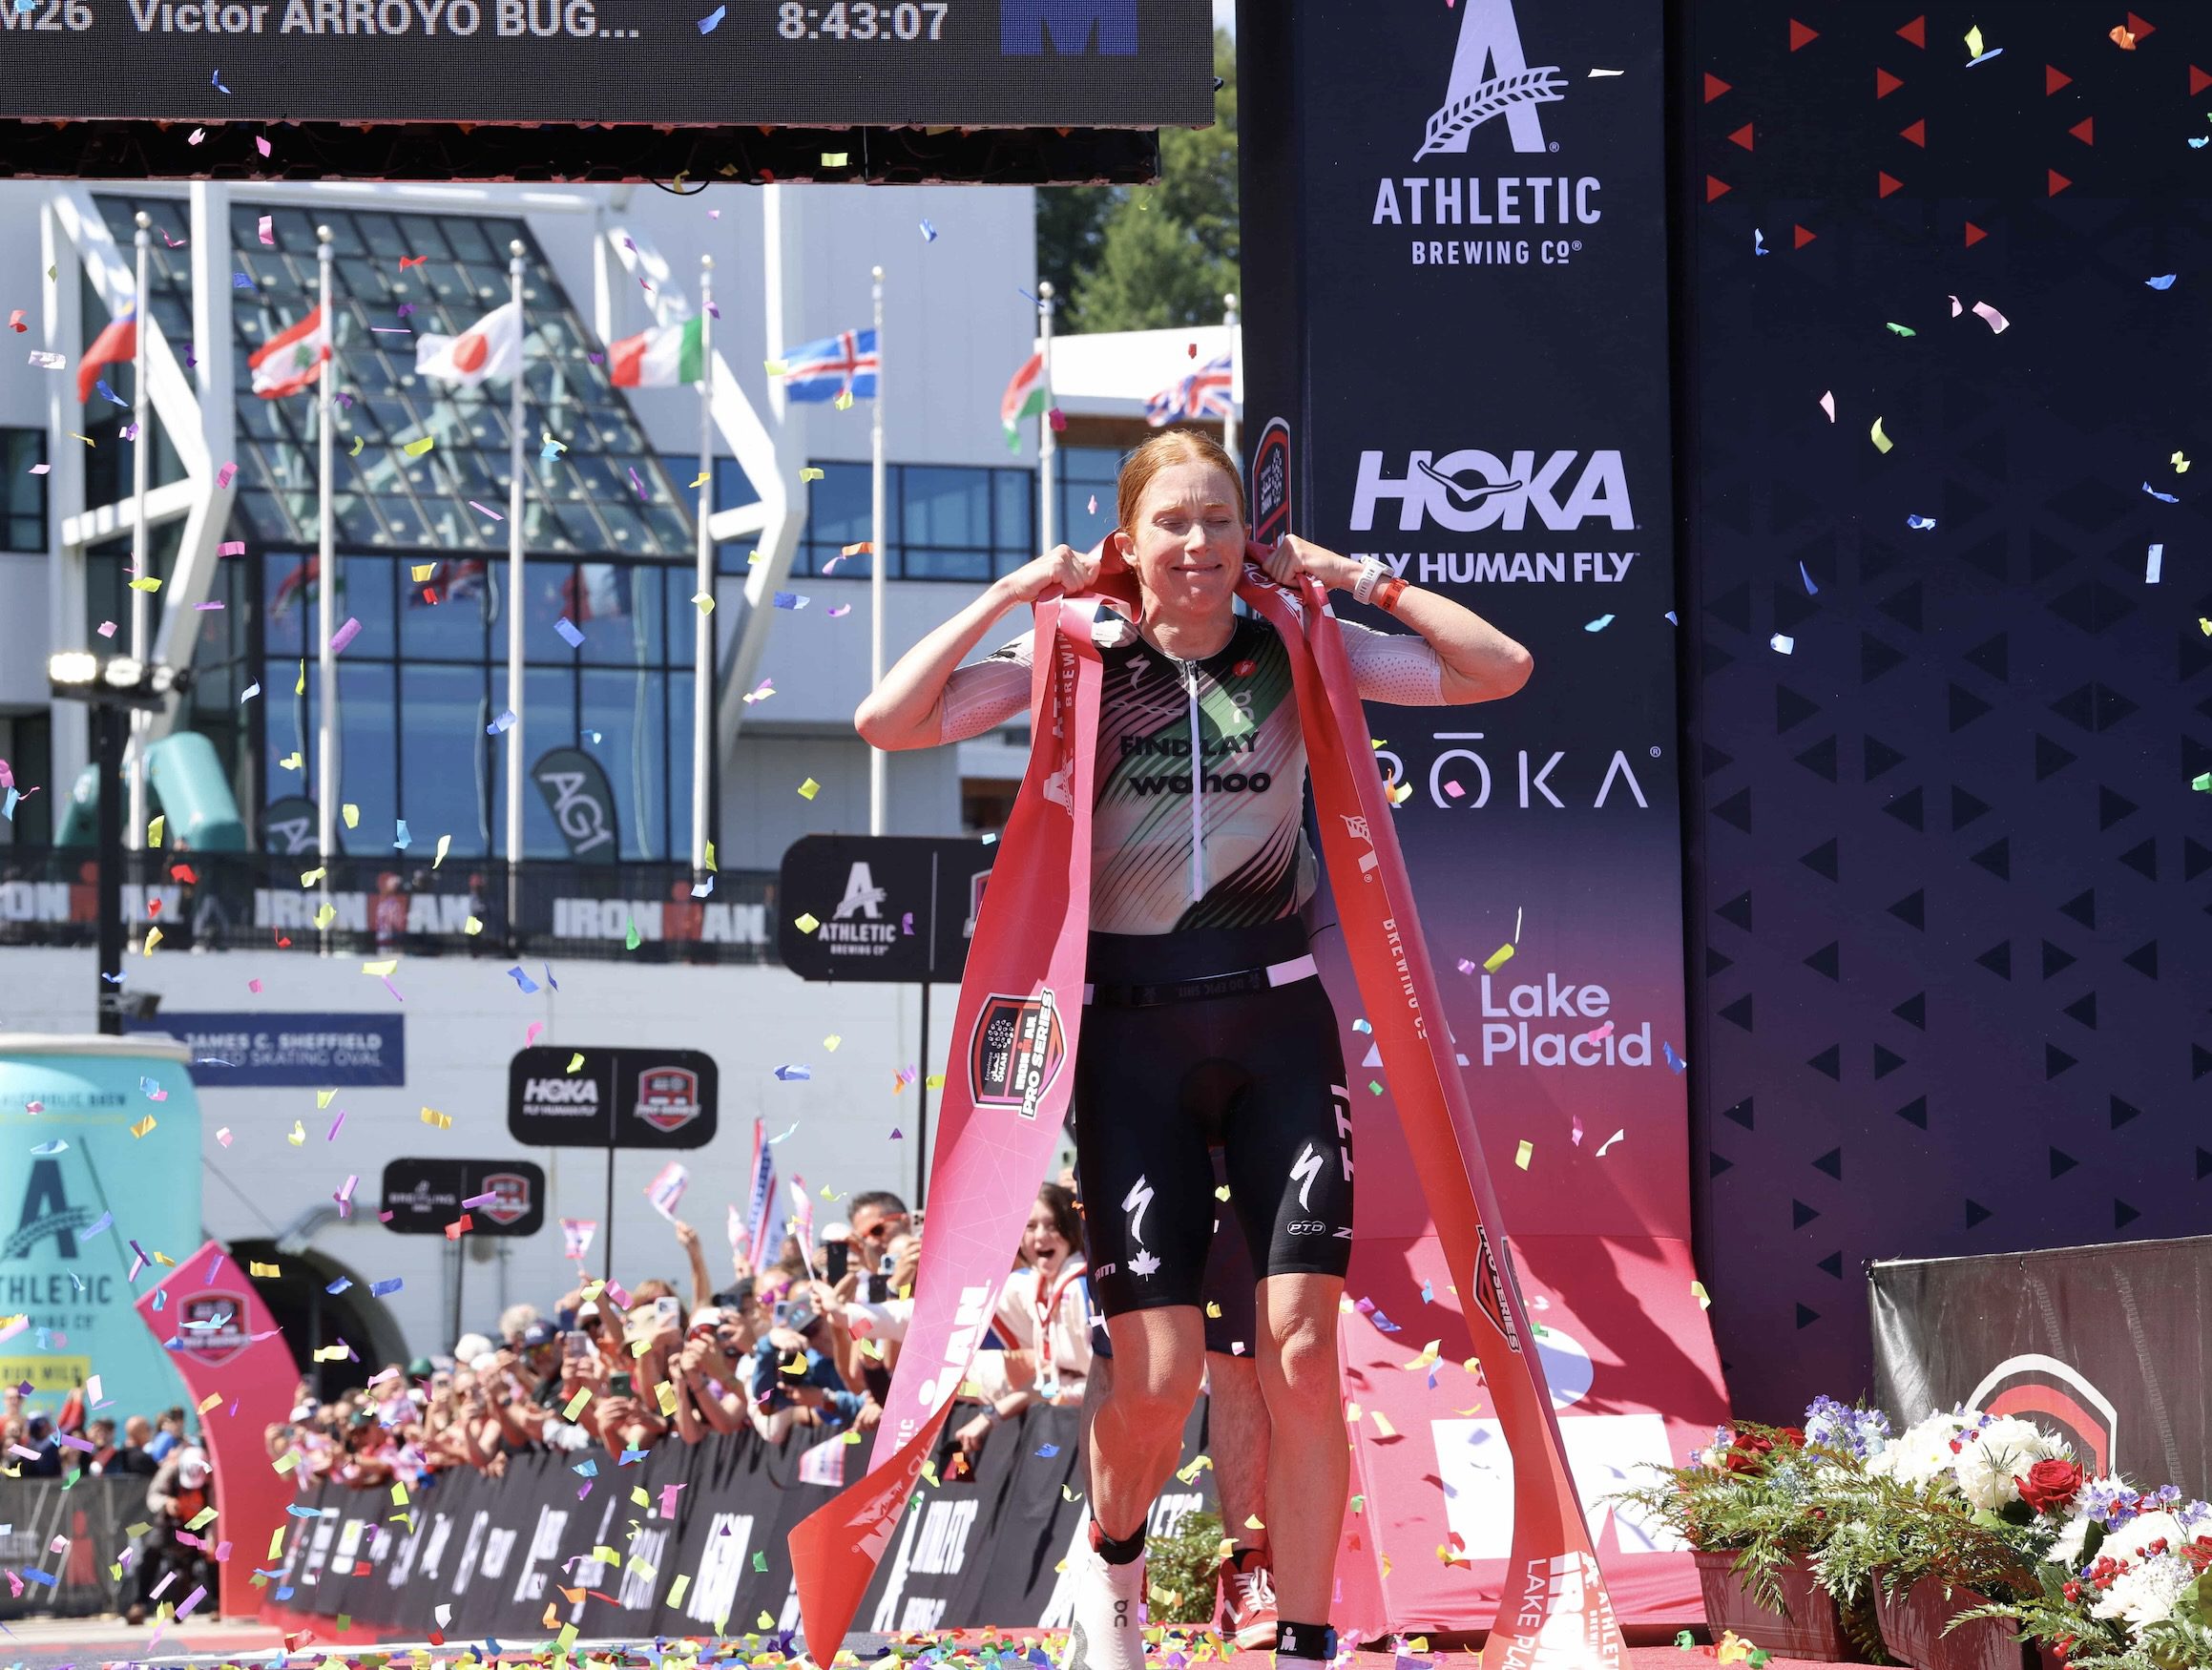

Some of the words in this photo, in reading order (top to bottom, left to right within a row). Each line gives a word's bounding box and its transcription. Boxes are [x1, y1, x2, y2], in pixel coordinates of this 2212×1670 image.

[129, 0, 269, 32] Victor
[280, 0, 478, 33] ARROYO
[777, 2, 949, 40] 8:43:07
[1372, 177, 1601, 224] ATHLETIC
[1412, 241, 1529, 264] BREWING
[1349, 449, 1636, 532] HOKA
[1419, 553, 1563, 582] HUMAN
[1575, 553, 1633, 582] FLY
[1120, 731, 1260, 757] FINDLAY
[1129, 765, 1271, 796] wahoo
[539, 771, 614, 854] AG1
[553, 881, 765, 943] IRONMAN
[818, 922, 897, 943] ATHLETIC
[1481, 973, 1610, 1017] Lake
[1023, 1070, 1040, 1116] PRO
[1032, 990, 1054, 1068] SERIES
[1482, 1021, 1652, 1067] Placid
[997, 1052, 1009, 1083] OMAN
[524, 1078, 599, 1103] HOKA
[1517, 1558, 1547, 1628] LAKE
